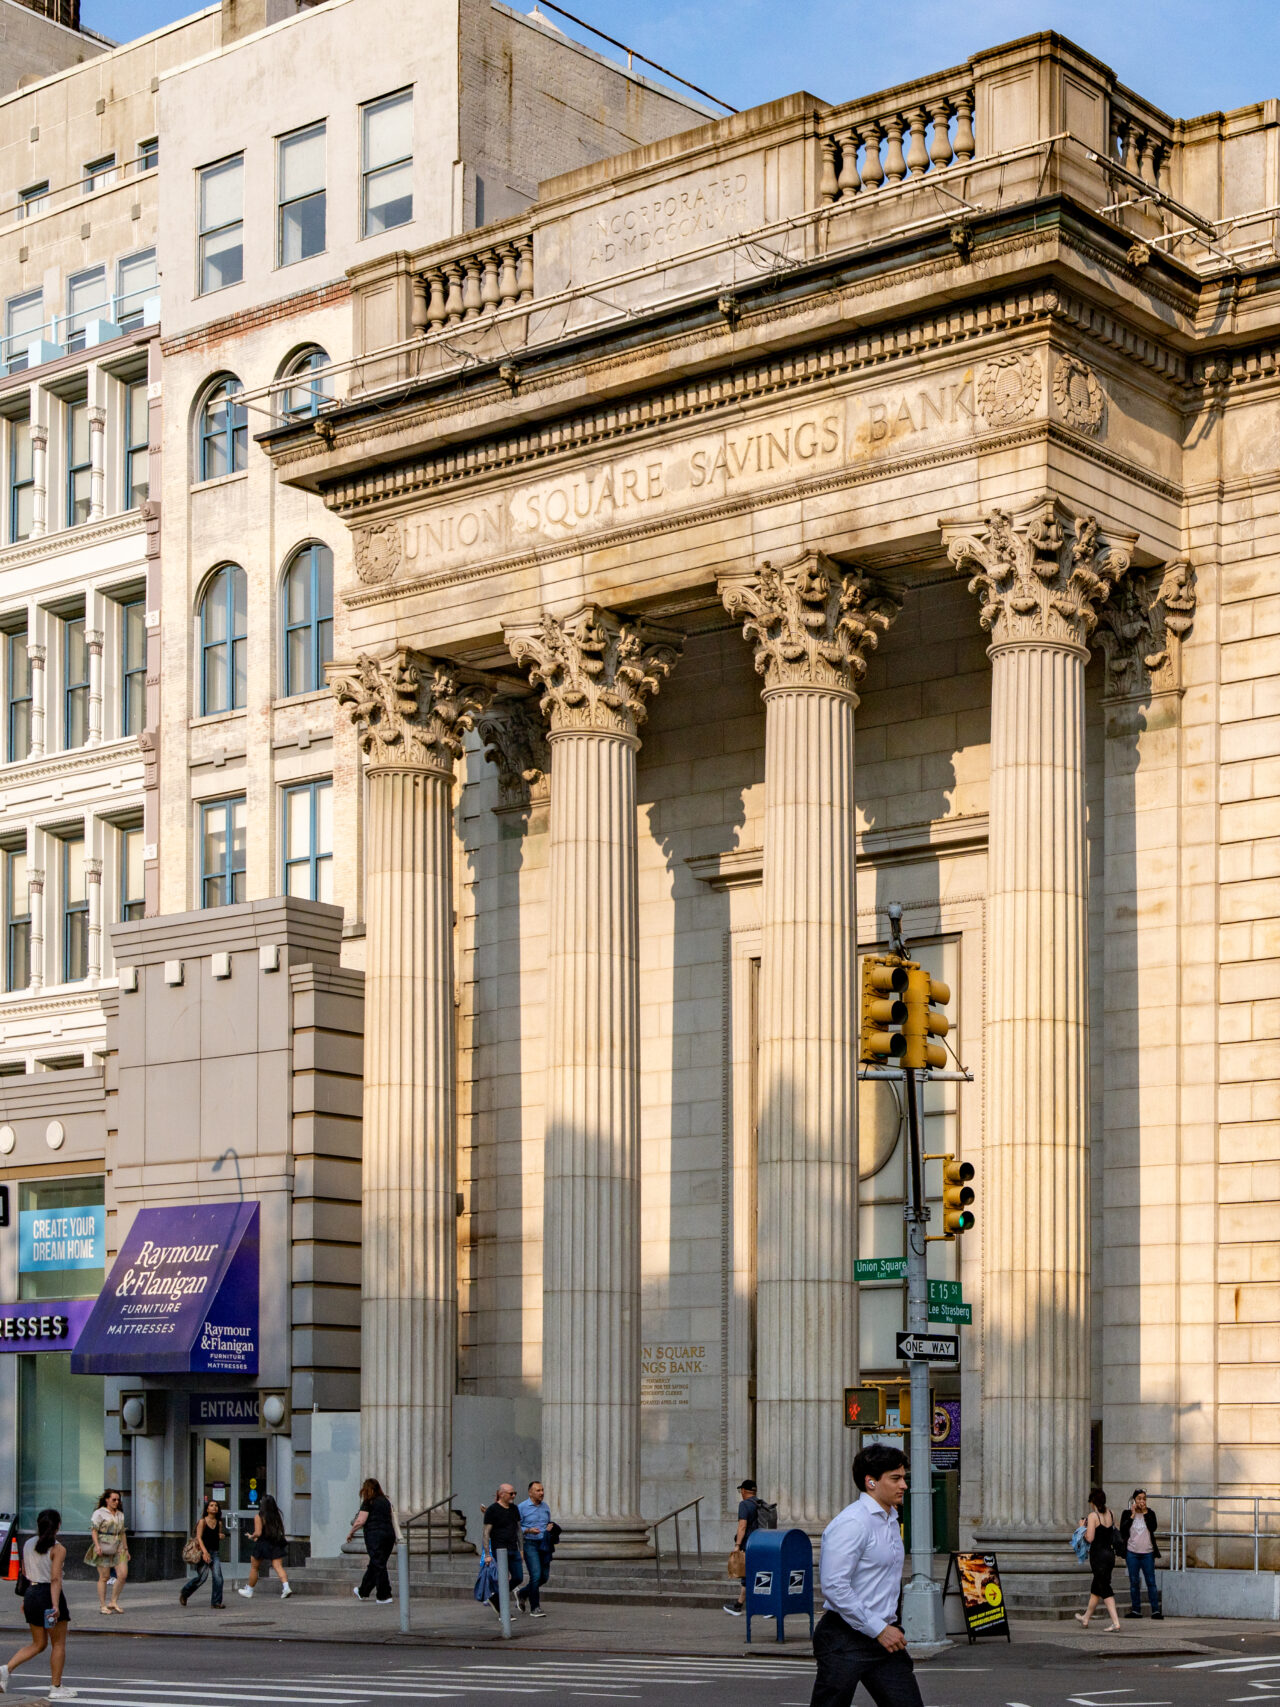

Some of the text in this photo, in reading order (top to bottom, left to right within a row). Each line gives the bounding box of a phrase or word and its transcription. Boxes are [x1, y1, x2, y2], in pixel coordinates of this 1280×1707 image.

[588, 174, 748, 239] INCORPORATED
[404, 380, 977, 560] UNION SQUARE SAVINGS BANK
[33, 1216, 95, 1239] CREATE YOUR
[33, 1239, 94, 1262] DREAM HOME
[134, 1240, 219, 1270] Raymour
[857, 1259, 907, 1273] Union Square
[115, 1268, 208, 1301] &Flanigan
[930, 1283, 958, 1299] E 15 St
[120, 1302, 182, 1315] FURNITURE
[928, 1304, 970, 1319] Lee Strasberg
[106, 1323, 176, 1335] MATTRESSES
[204, 1321, 252, 1337] Raymour
[200, 1335, 254, 1354] &Flanigan
[905, 1341, 951, 1353] ONE WAY
[209, 1353, 246, 1361] FURNITURE
[656, 1346, 706, 1360] SQUARE
[207, 1362, 248, 1370] MATTRESSES
[670, 1361, 702, 1374] BANK
[200, 1400, 259, 1418] ENTRANC
